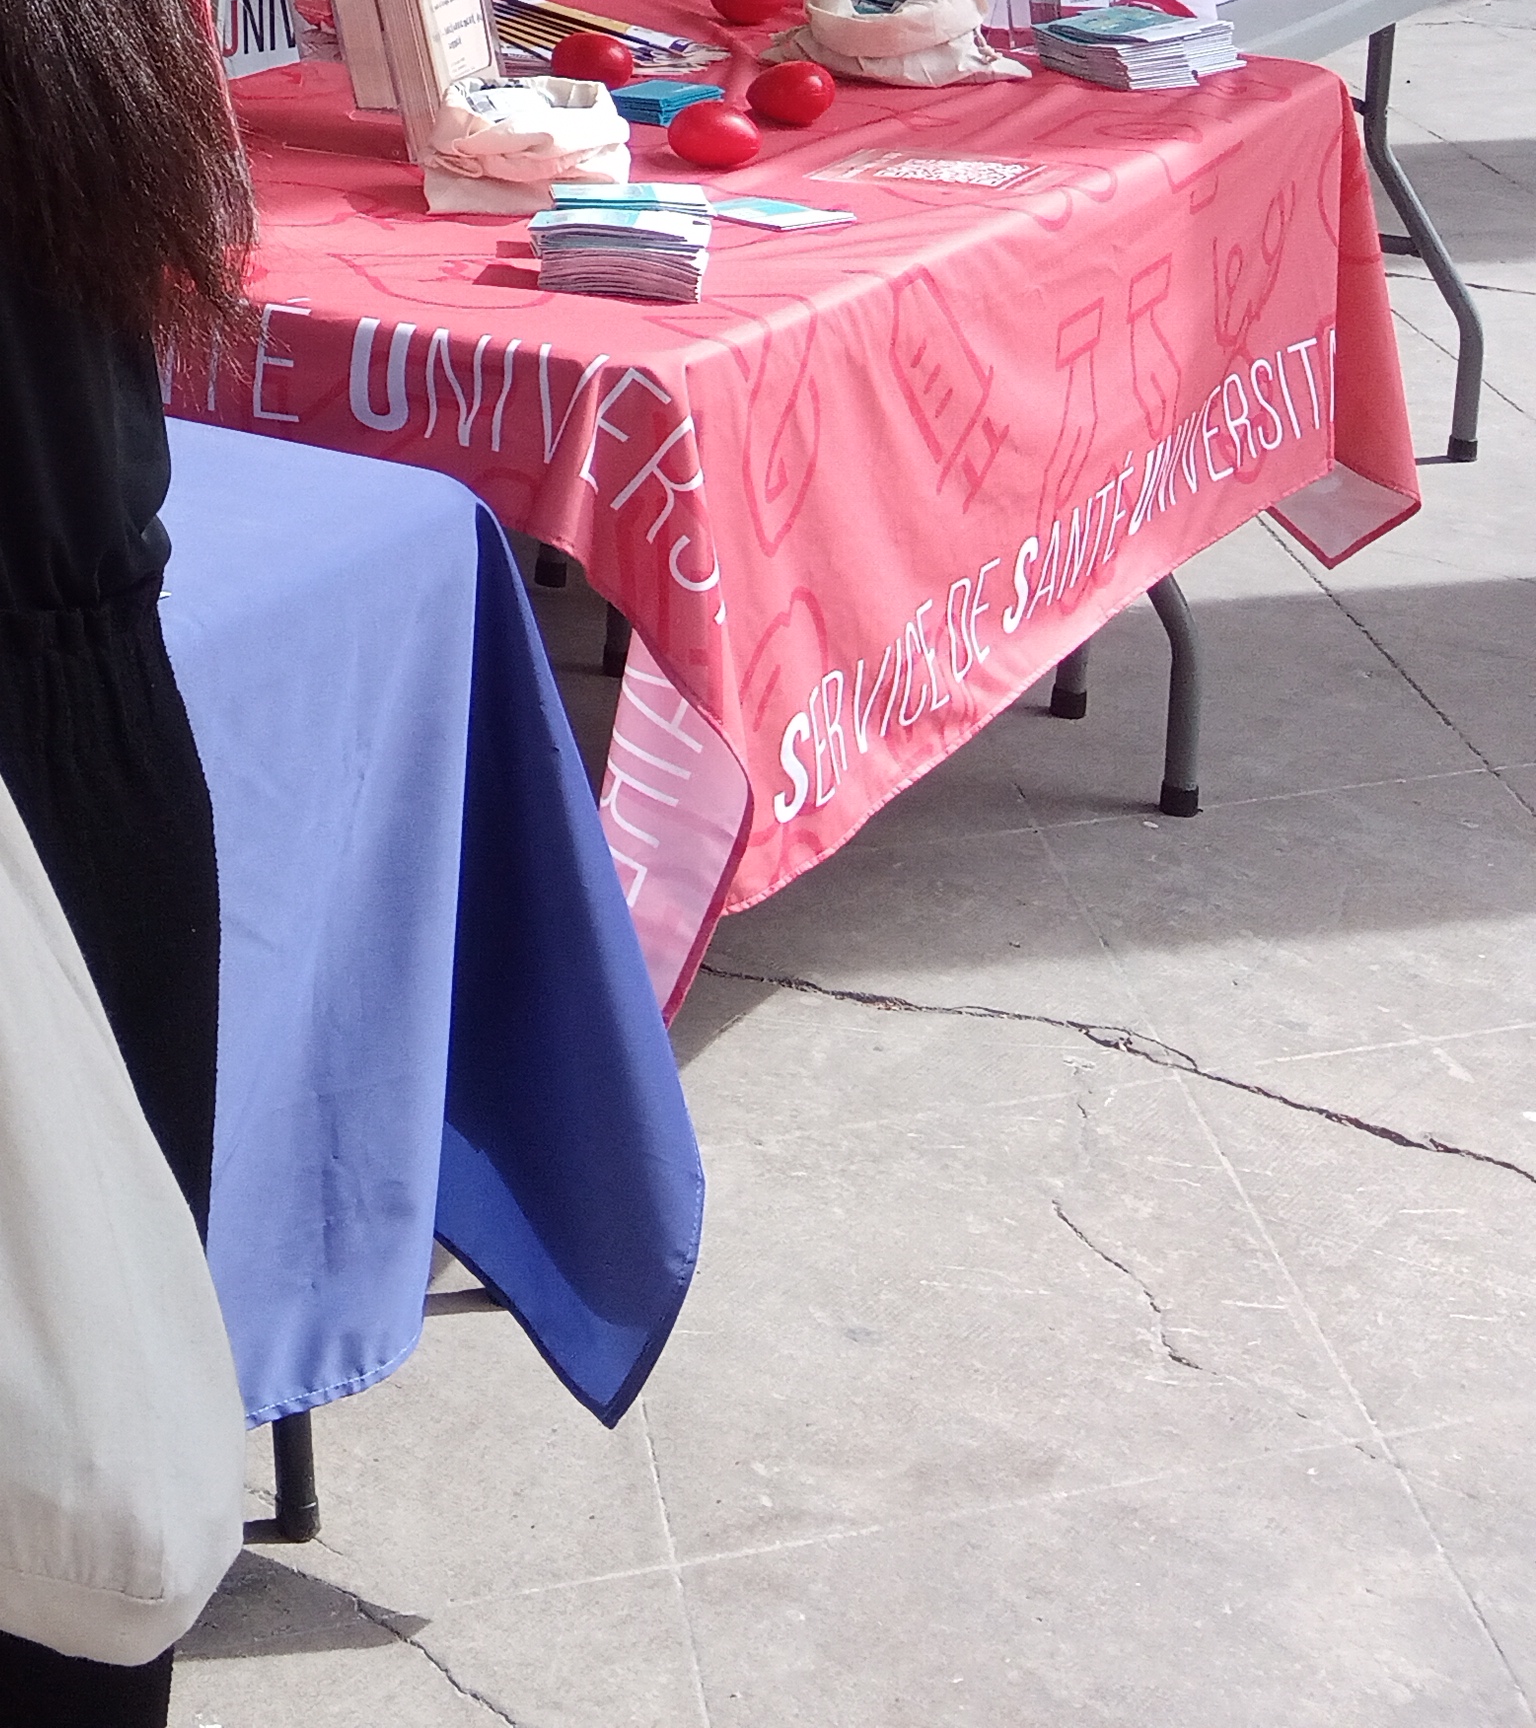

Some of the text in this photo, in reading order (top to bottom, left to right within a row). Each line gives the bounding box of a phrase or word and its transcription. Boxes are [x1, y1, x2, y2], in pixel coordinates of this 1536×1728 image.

[772, 599, 953, 825] SERVICE
[945, 557, 1002, 683] DE
[1002, 449, 1134, 635] SANTÉ
